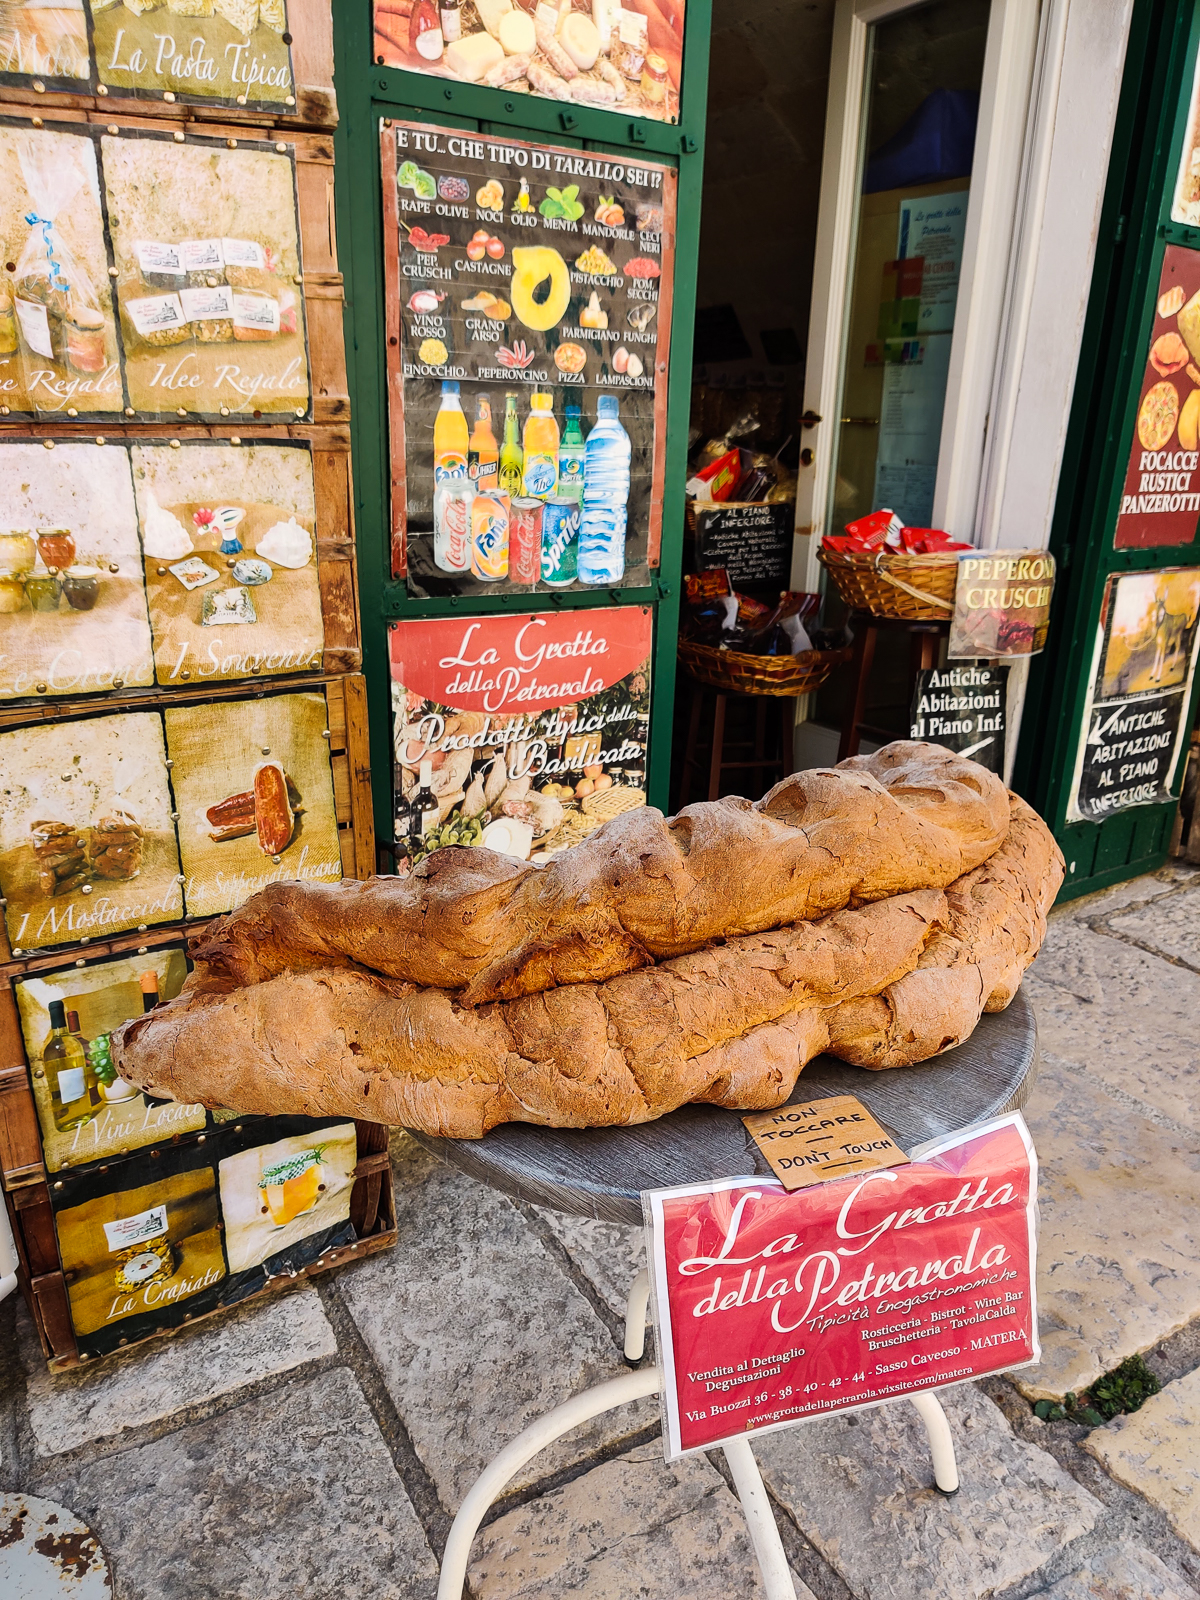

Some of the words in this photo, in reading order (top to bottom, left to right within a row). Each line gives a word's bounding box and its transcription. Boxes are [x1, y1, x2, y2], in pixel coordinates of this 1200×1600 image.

[4, 29, 91, 79] Matera
[107, 28, 148, 73] La
[153, 36, 220, 82] Pasta
[224, 38, 292, 100] Tipica
[397, 130, 409, 147] E
[448, 138, 485, 160] CHE
[487, 143, 528, 167] TIPO
[531, 151, 551, 170] DI
[554, 155, 624, 181] TARALLO
[627, 166, 650, 187] SEI
[401, 199, 431, 214] RAPE
[435, 205, 469, 218] OLIVE
[476, 209, 504, 224] NOCI
[510, 213, 537, 227] OLIO
[543, 217, 578, 232] MENTA
[582, 223, 635, 241] MANDORLE
[639, 231, 660, 243] CECI
[639, 242, 660, 254] NERI
[402, 265, 452, 280] CRUSCHI
[627, 289, 658, 302] SECCHI
[416, 254, 439, 268] PEP.
[455, 260, 512, 276] CASTAGNE
[570, 272, 624, 288] PISTACCHIO
[410, 326, 446, 339] ROSSO
[471, 330, 500, 342] ARSO
[414, 315, 443, 327] VINO
[465, 319, 505, 331] GRANO
[562, 327, 620, 342] PARMIGIANO
[623, 332, 657, 345] FUNGHI
[28, 363, 122, 412] Regalo
[149, 353, 205, 389] Idee
[213, 356, 307, 414] Regalo
[478, 367, 548, 382] PEPERONCINO
[558, 372, 585, 384] PIZZA
[595, 374, 653, 388] LAMPASCIONI
[1139, 451, 1199, 471] FOCACCE
[1139, 472, 1192, 493] RUSTICI
[726, 508, 738, 518] AL
[742, 506, 770, 517] PIANO
[1120, 493, 1200, 515] PANZEROTTI
[474, 518, 508, 559] Fanta
[720, 516, 775, 529] INFERIORE:
[541, 511, 581, 578] Sprite
[965, 585, 1051, 609] CRUSCHI
[198, 639, 323, 677] Souvenir
[438, 623, 500, 669] La
[515, 619, 610, 673] Grotta
[445, 672, 496, 695] della
[483, 666, 606, 712] Petrarola
[928, 667, 991, 688] Antiche
[916, 690, 1000, 714] Abitazioni
[396, 714, 537, 764] Prodotti
[545, 706, 607, 745] tipici
[606, 705, 638, 723] della
[910, 720, 925, 738] al
[928, 716, 973, 737] Piano
[976, 712, 1004, 732] Inf.
[1108, 708, 1168, 737] ANTICHE
[509, 739, 644, 780] Basilicata
[1091, 730, 1172, 764] ABITAZIONI
[1097, 768, 1114, 789] AL
[1119, 757, 1159, 783] PIANO
[1089, 780, 1159, 815] INFERIORE
[36, 873, 182, 939] Mostaccioli
[184, 876, 205, 901] La
[85, 1109, 135, 1145] Vini
[761, 1113, 866, 1140] TOCCARE
[771, 1107, 818, 1125] NON
[777, 1150, 830, 1170] DON'T
[840, 1139, 893, 1155] TOUCH
[678, 1191, 804, 1276] La
[836, 1171, 1018, 1256] Grotta
[106, 1295, 137, 1320] La
[143, 1267, 225, 1305] Crapiata
[692, 1263, 796, 1318] della
[770, 1227, 1012, 1334] Petrarola
[806, 1306, 870, 1334] Tipicità
[876, 1268, 1018, 1314] Enogastronomiche
[861, 1318, 922, 1340] Rosticceria
[930, 1305, 966, 1322] Bistrot
[974, 1295, 1002, 1310] Wine
[1004, 1290, 1024, 1303] Bar
[868, 1325, 941, 1351] Bruschetteria
[950, 1305, 1017, 1330] TavolaCalda
[686, 1408, 707, 1423] Via
[710, 1397, 751, 1418] Buozzi
[754, 1390, 769, 1406] 36
[778, 1385, 793, 1401] 38
[803, 1381, 818, 1395] 40
[828, 1377, 842, 1390] 42
[852, 1371, 866, 1383] 44
[875, 1359, 908, 1376] Sasso
[910, 1347, 961, 1366] Caveoso
[970, 1329, 1027, 1352] MATERA
[687, 1366, 735, 1384] Vendita
[737, 1361, 749, 1372] al
[752, 1347, 806, 1370] Dettaglio
[705, 1364, 781, 1393] Degustazioni
[747, 1366, 973, 1426] www.grottadellapetrarola.wixsite.com/matera
